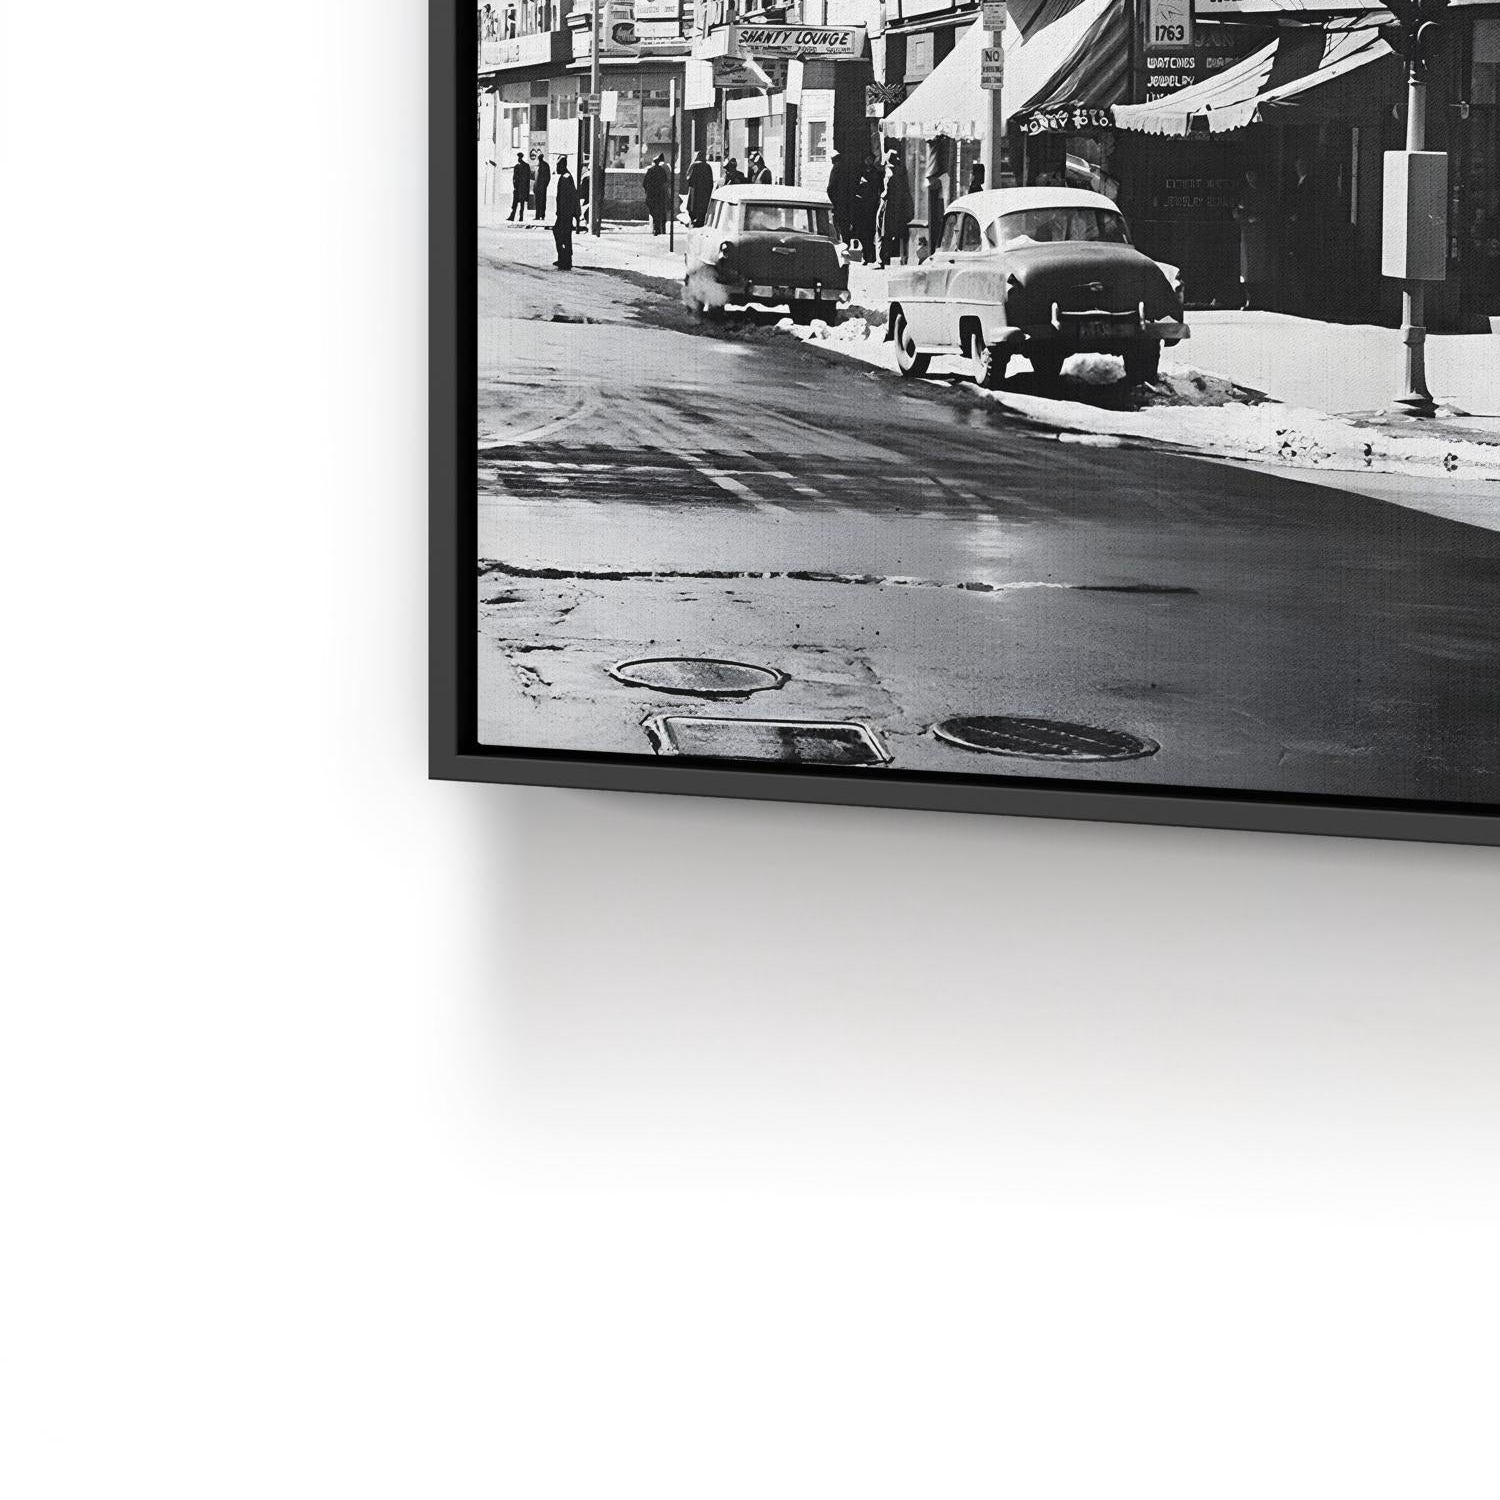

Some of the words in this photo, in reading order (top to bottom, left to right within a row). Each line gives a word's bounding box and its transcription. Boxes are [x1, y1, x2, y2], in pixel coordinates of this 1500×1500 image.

[738, 30, 793, 45] SHANTY
[795, 31, 850, 46] LOUNGE
[1155, 25, 1185, 41] 1763
[985, 50, 1000, 62] NO
